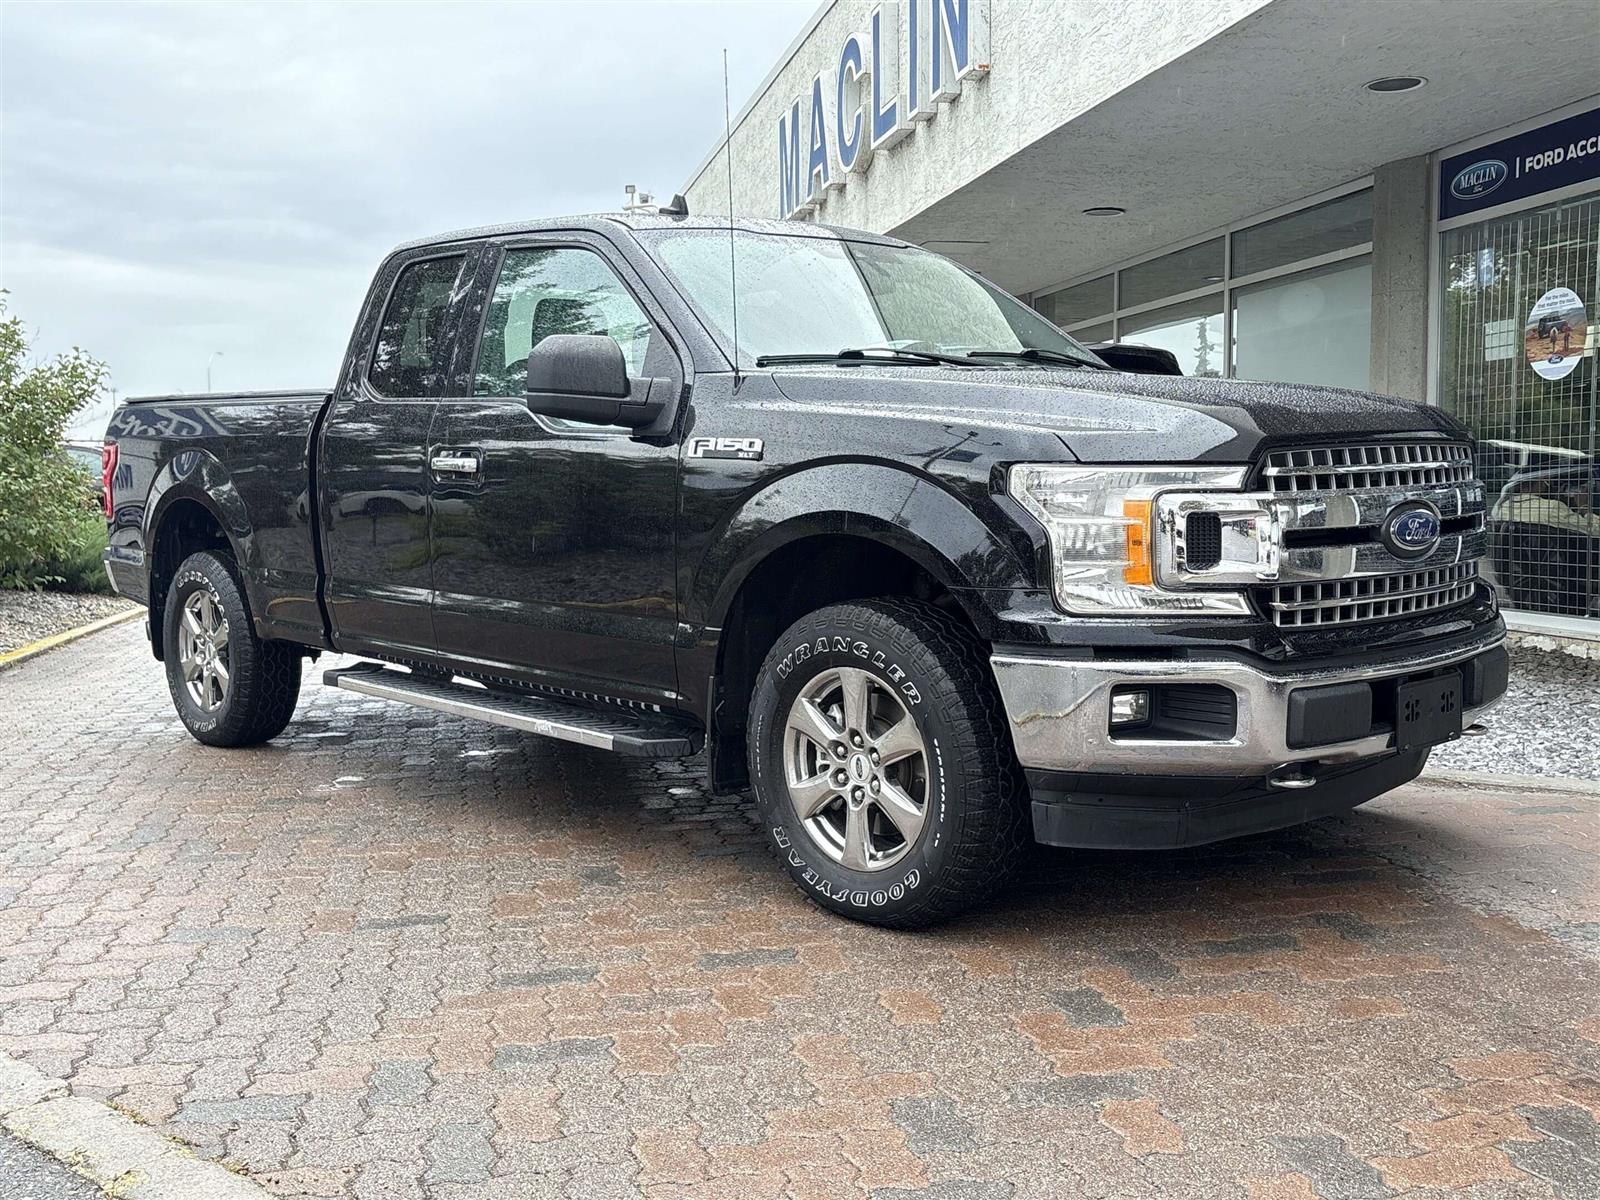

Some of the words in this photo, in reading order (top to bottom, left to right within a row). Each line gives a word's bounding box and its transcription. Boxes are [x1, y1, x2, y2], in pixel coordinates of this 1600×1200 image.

[778, 0, 974, 220] MACLIN
[1459, 165, 1498, 190] MACLIN
[1525, 147, 1564, 173] FORD
[1405, 517, 1434, 540] Ford
[776, 636, 922, 706] WRANGLER
[772, 826, 921, 908] GOODYEAR
